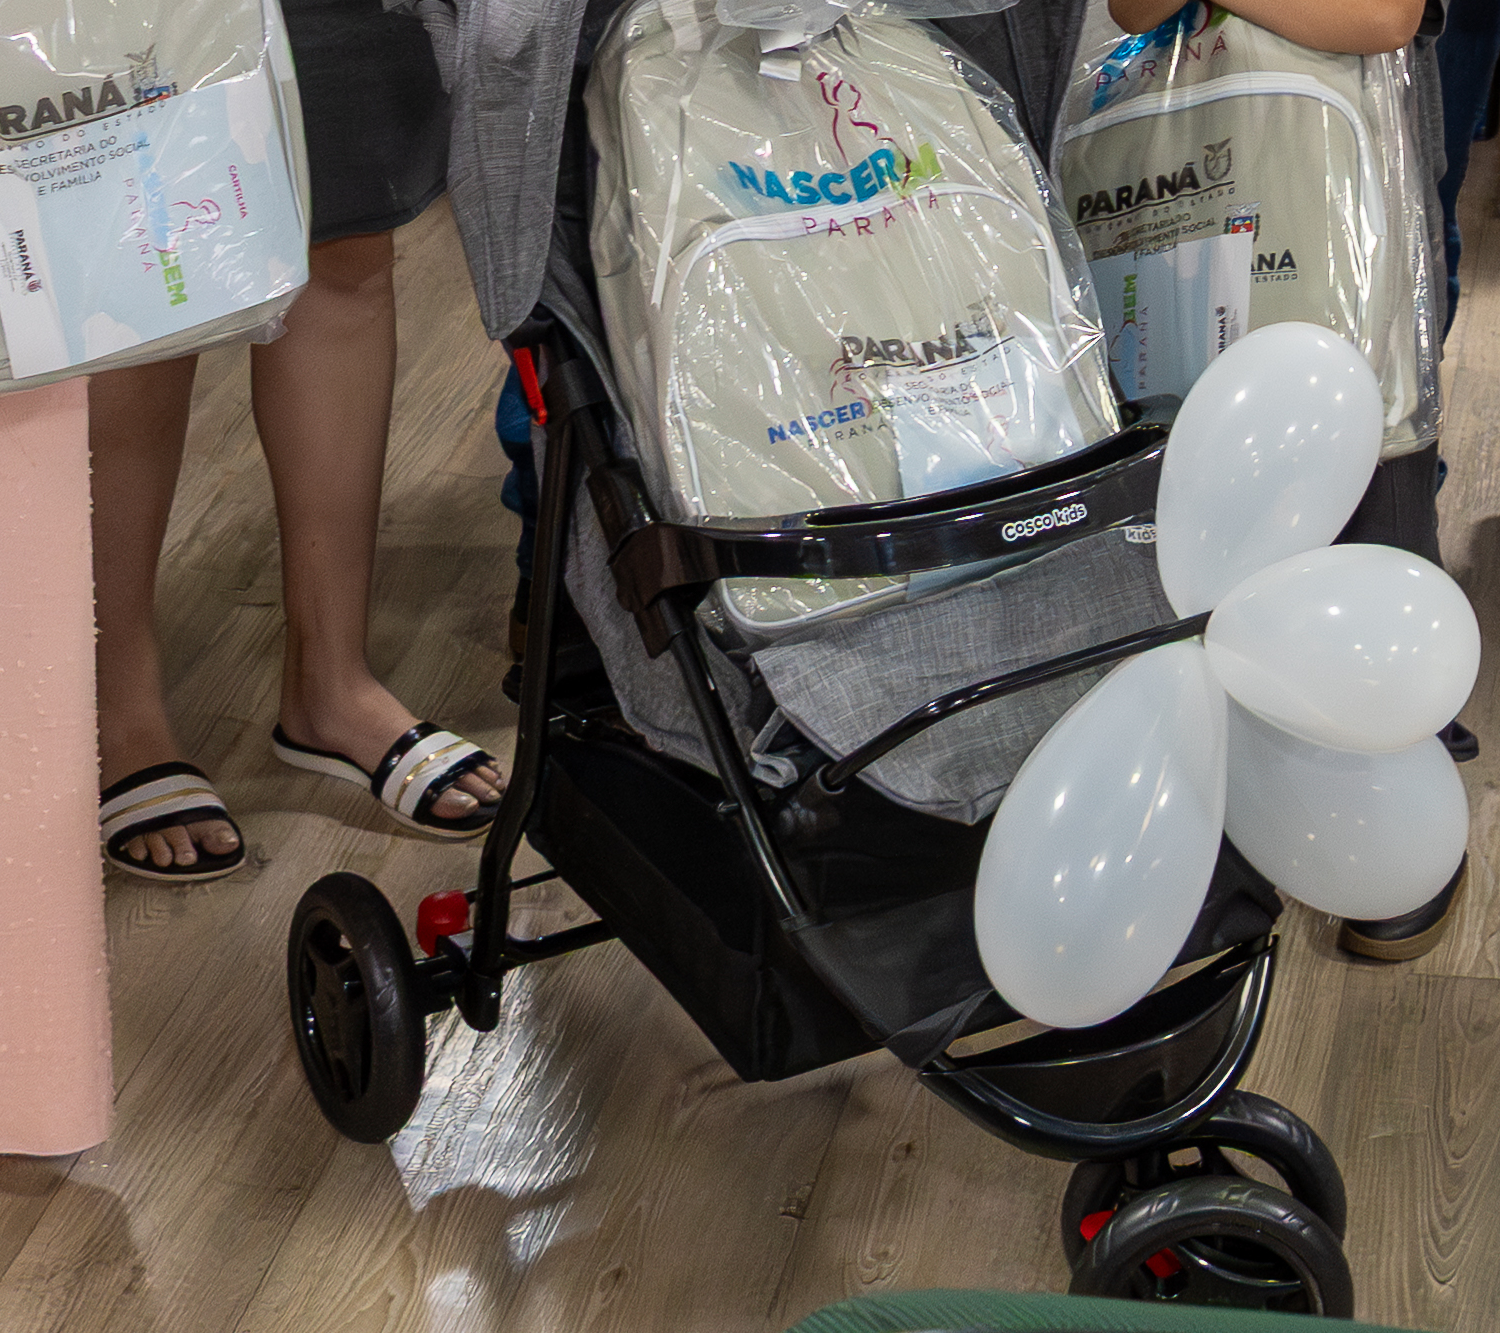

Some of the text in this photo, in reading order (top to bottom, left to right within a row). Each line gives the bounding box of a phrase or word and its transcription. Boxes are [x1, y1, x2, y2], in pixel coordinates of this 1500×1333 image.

[100, 135, 118, 150] DO
[37, 184, 46, 197] E
[1077, 162, 1201, 221] PARANÁ
[1052, 503, 1088, 527] kids
